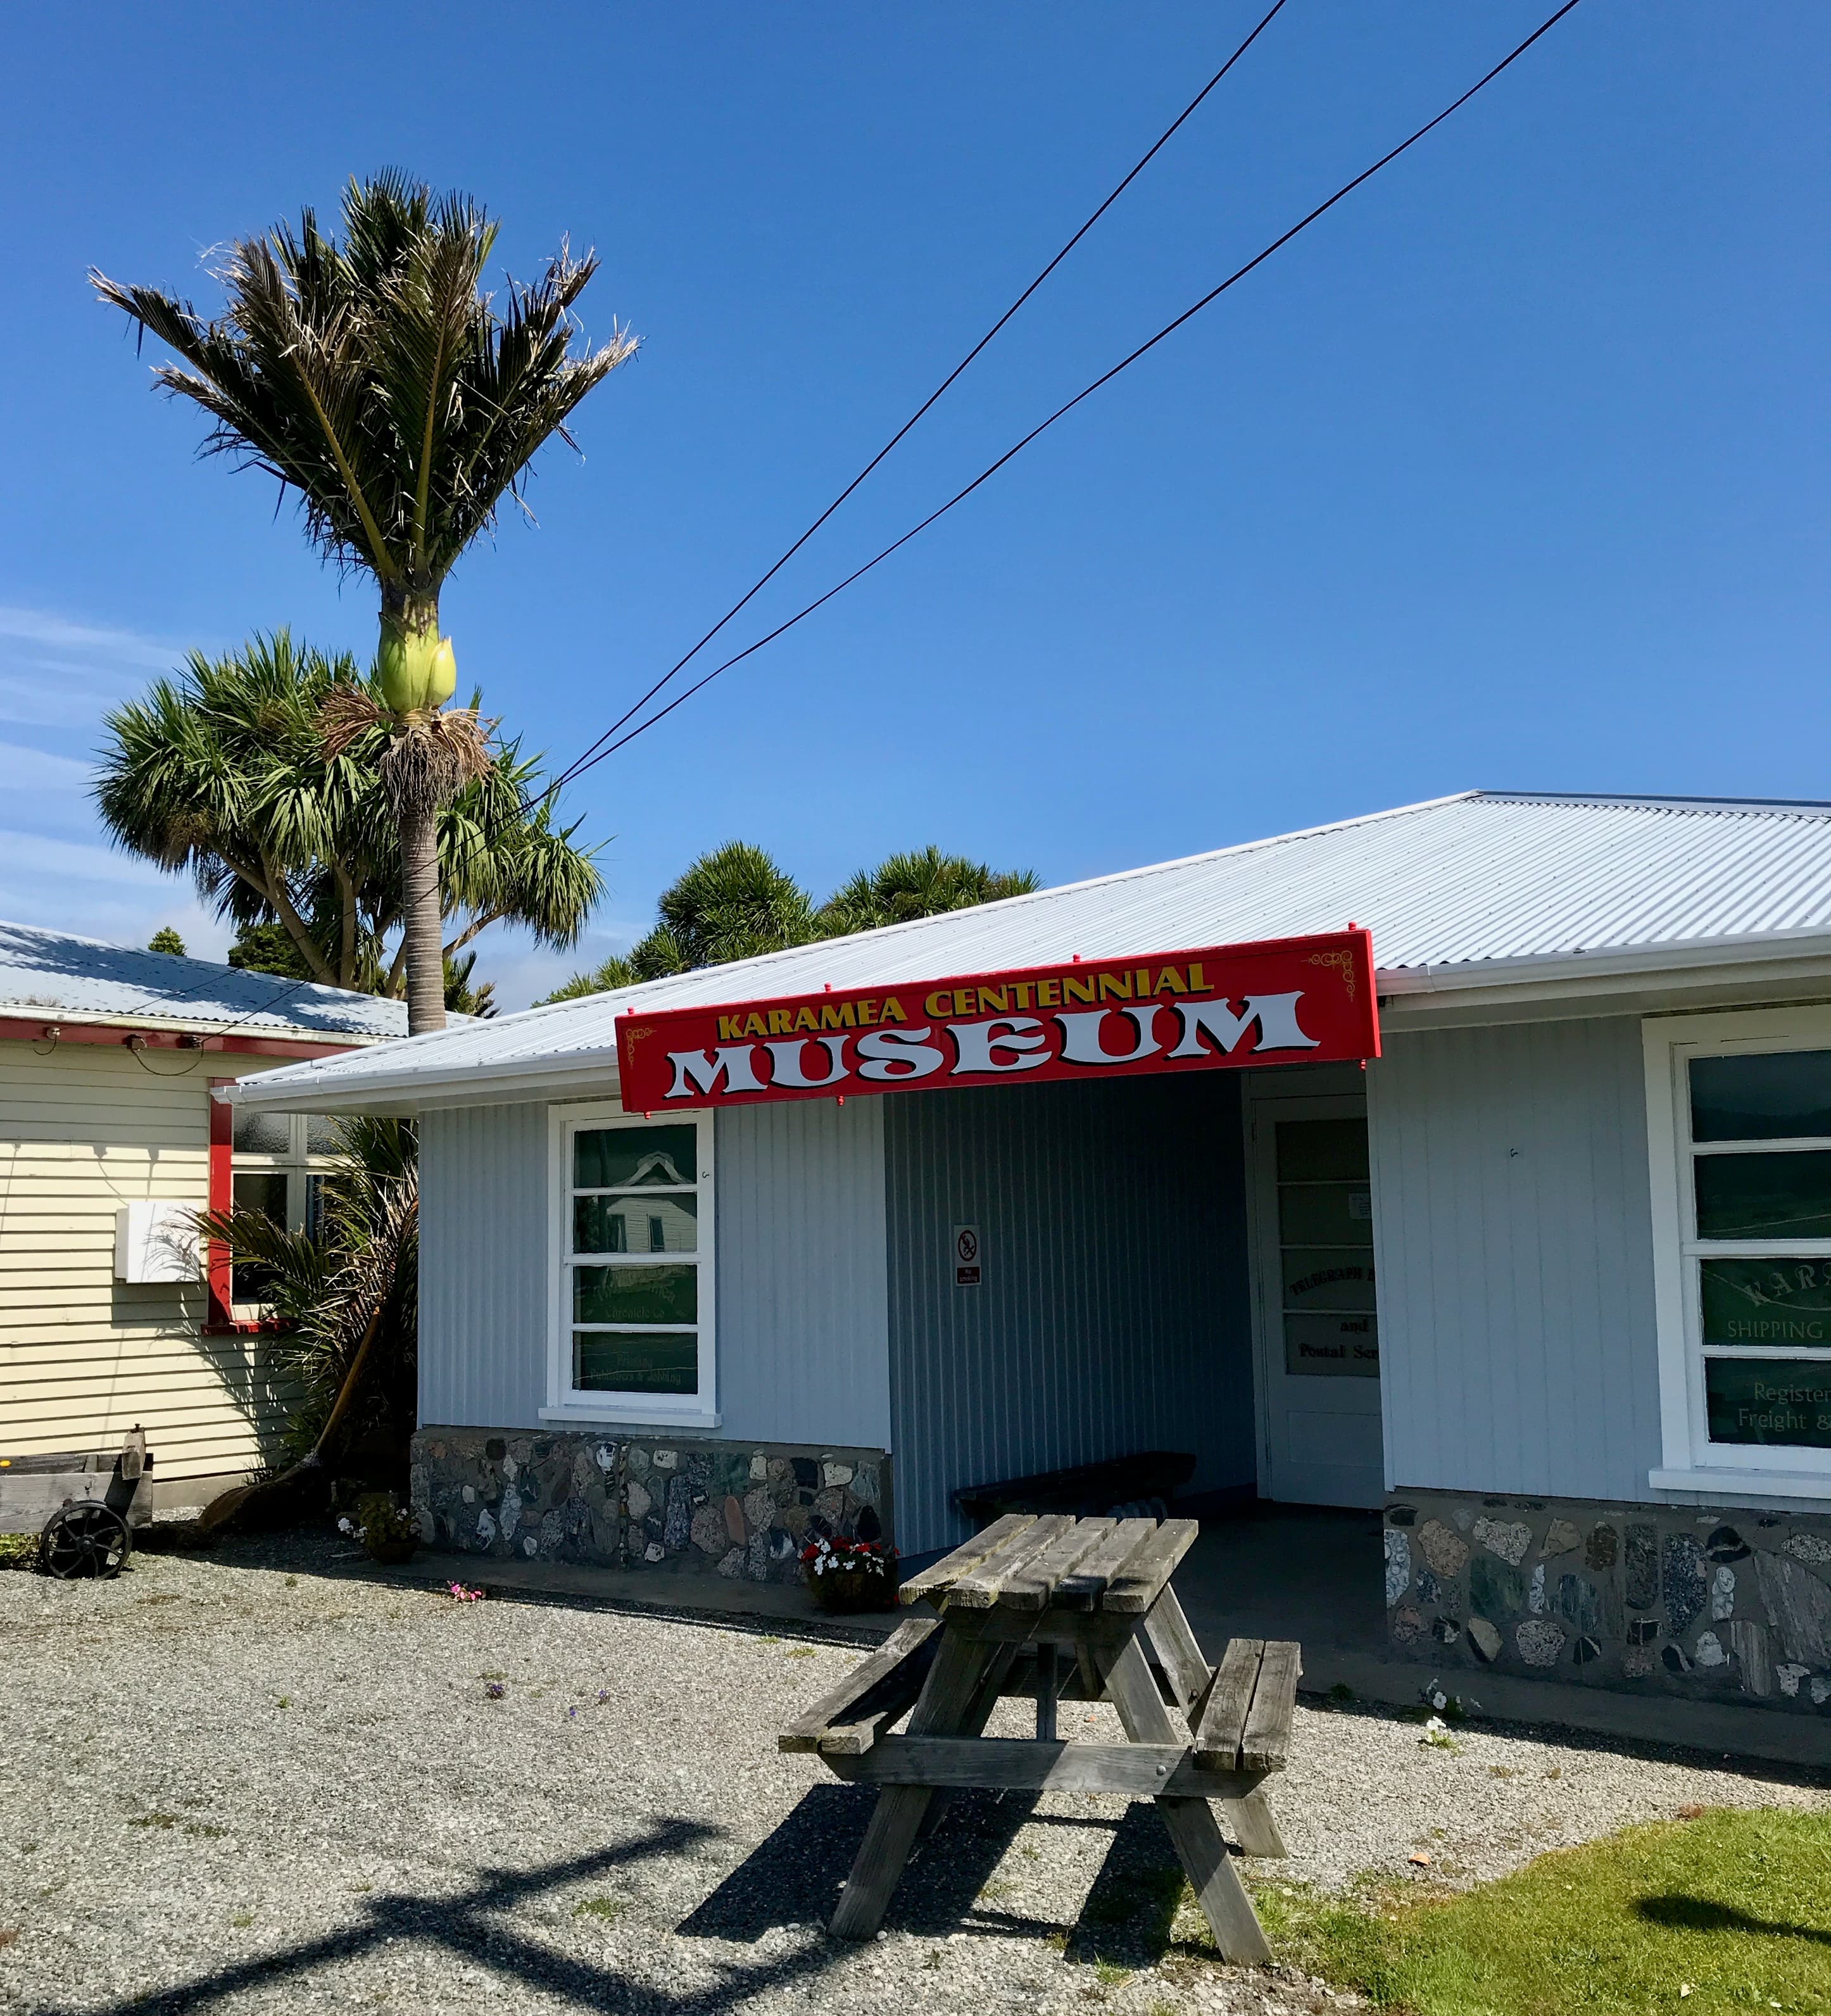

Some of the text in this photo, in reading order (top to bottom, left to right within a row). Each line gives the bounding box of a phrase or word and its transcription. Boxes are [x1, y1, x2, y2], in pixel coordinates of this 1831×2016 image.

[717, 962, 1215, 1040] KARAMEA CENTENNIAL
[662, 991, 1321, 1100] MUSEUM
[1289, 1267, 1362, 1296] TELEGRAPH
[1340, 1319, 1369, 1333] and
[1728, 1321, 1823, 1339] SHIPPING
[1299, 1343, 1345, 1358] Postal
[1739, 1408, 1807, 1432] Freight
